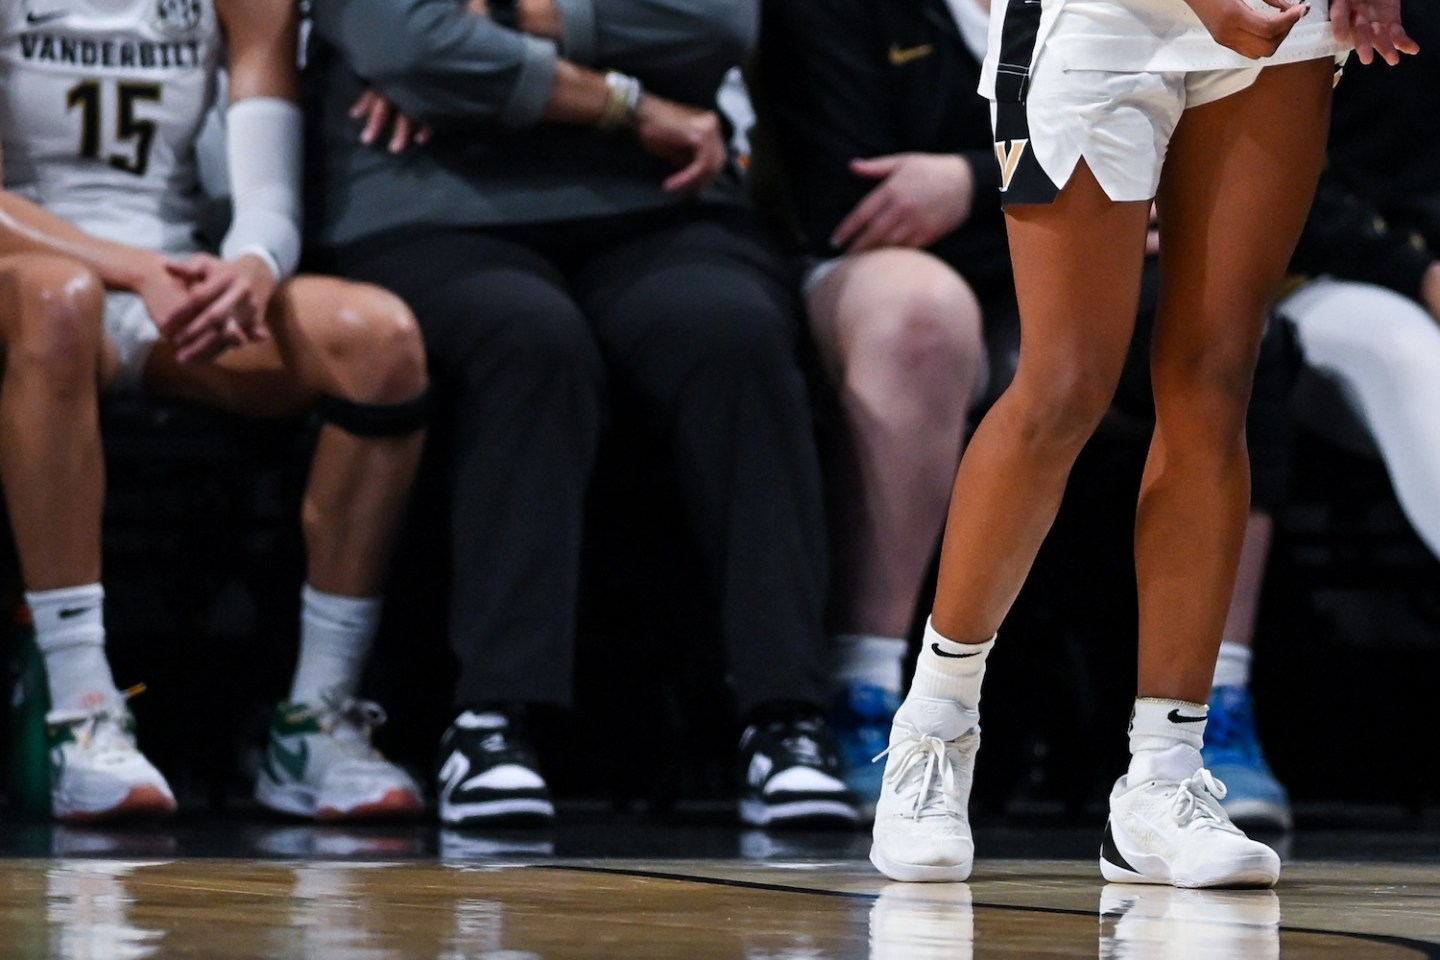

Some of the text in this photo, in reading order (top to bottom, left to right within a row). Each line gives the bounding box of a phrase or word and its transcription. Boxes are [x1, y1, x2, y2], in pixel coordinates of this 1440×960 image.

[19, 33, 199, 69] VANDERBILT
[67, 77, 163, 177] 15
[994, 138, 1028, 192] V
